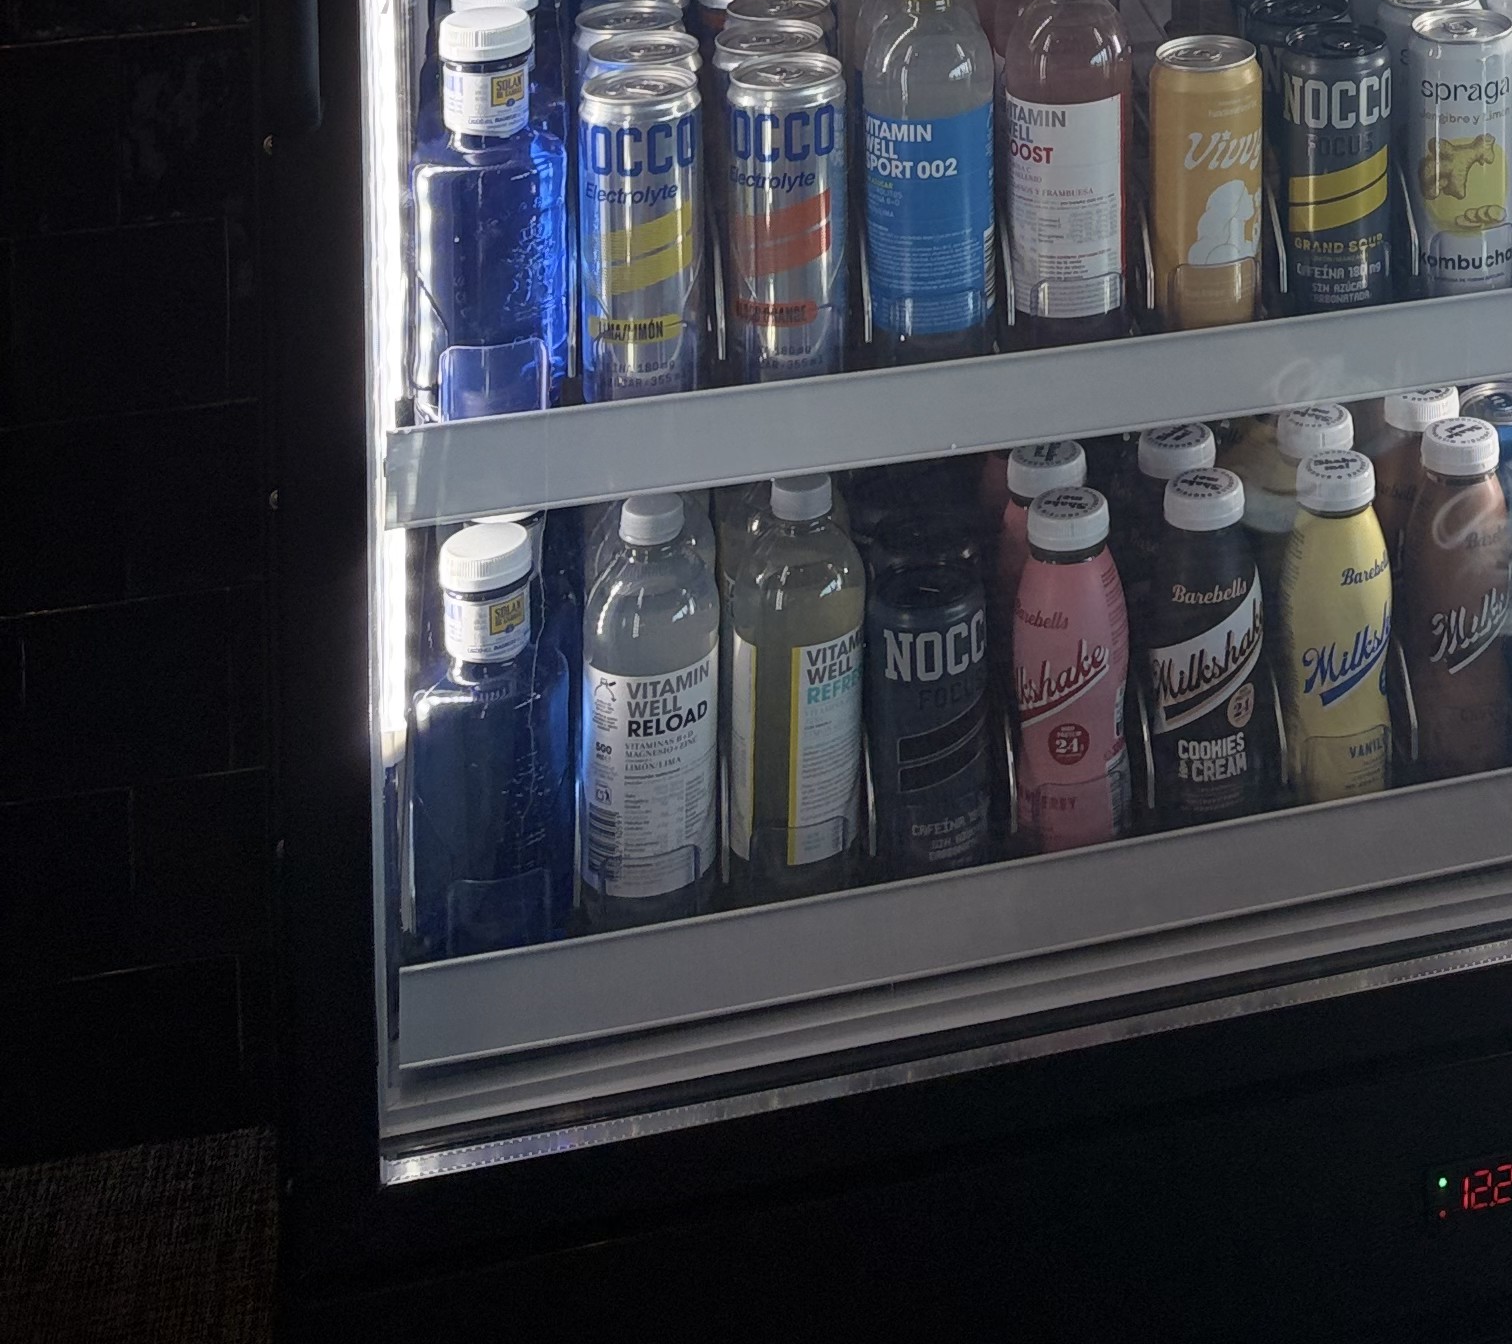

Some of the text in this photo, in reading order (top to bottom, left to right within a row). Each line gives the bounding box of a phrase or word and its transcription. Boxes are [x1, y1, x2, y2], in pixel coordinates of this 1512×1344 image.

[1283, 67, 1392, 129] NOCCO
[1421, 76, 1510, 105] spraga
[866, 151, 957, 179] SPORT 002
[729, 165, 816, 194] Electrolyte
[585, 181, 678, 207] Electrolyte
[1294, 233, 1383, 253] GRAND SOUR
[1296, 262, 1345, 279] CAFEÍNA
[1419, 247, 1512, 271] kombucha
[1172, 577, 1248, 604] Barebells
[627, 660, 710, 700] VITAMIN
[807, 656, 853, 686] WELL
[627, 695, 682, 719] WELL
[628, 700, 708, 738] RELOAD
[625, 737, 675, 750] VITAMINAS
[1178, 732, 1245, 760] COOKIES
[1191, 752, 1247, 783] CREAM
